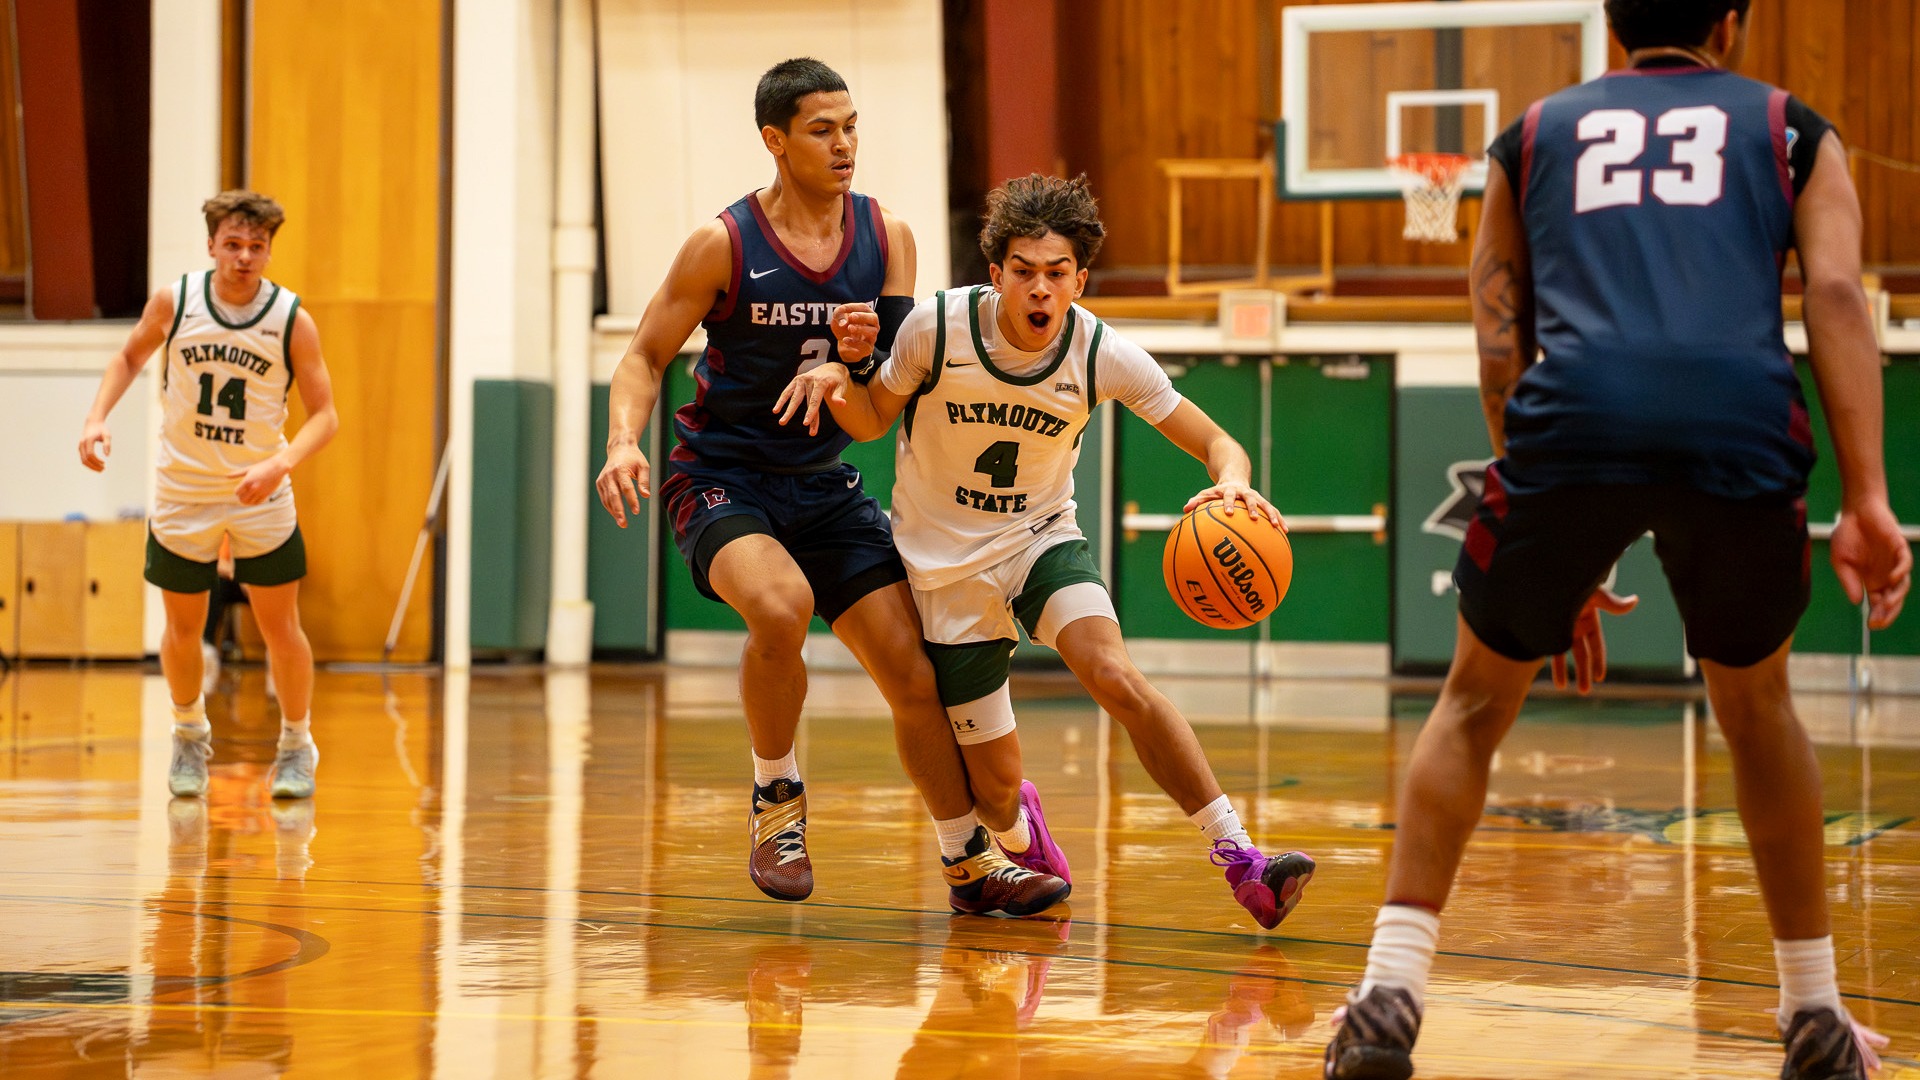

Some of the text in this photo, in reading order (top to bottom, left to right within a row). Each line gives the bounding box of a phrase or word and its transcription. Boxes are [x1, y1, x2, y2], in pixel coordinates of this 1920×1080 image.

[1574, 104, 1729, 214] 23
[180, 344, 272, 376] PLYMOUTH
[796, 338, 831, 375] 2
[197, 372, 247, 420] 14
[194, 421, 245, 445] STATE
[945, 401, 1070, 437] PLYMOUTH
[973, 440, 1020, 488] 4
[955, 485, 1028, 513] STATE
[1212, 536, 1266, 615] Wilson
